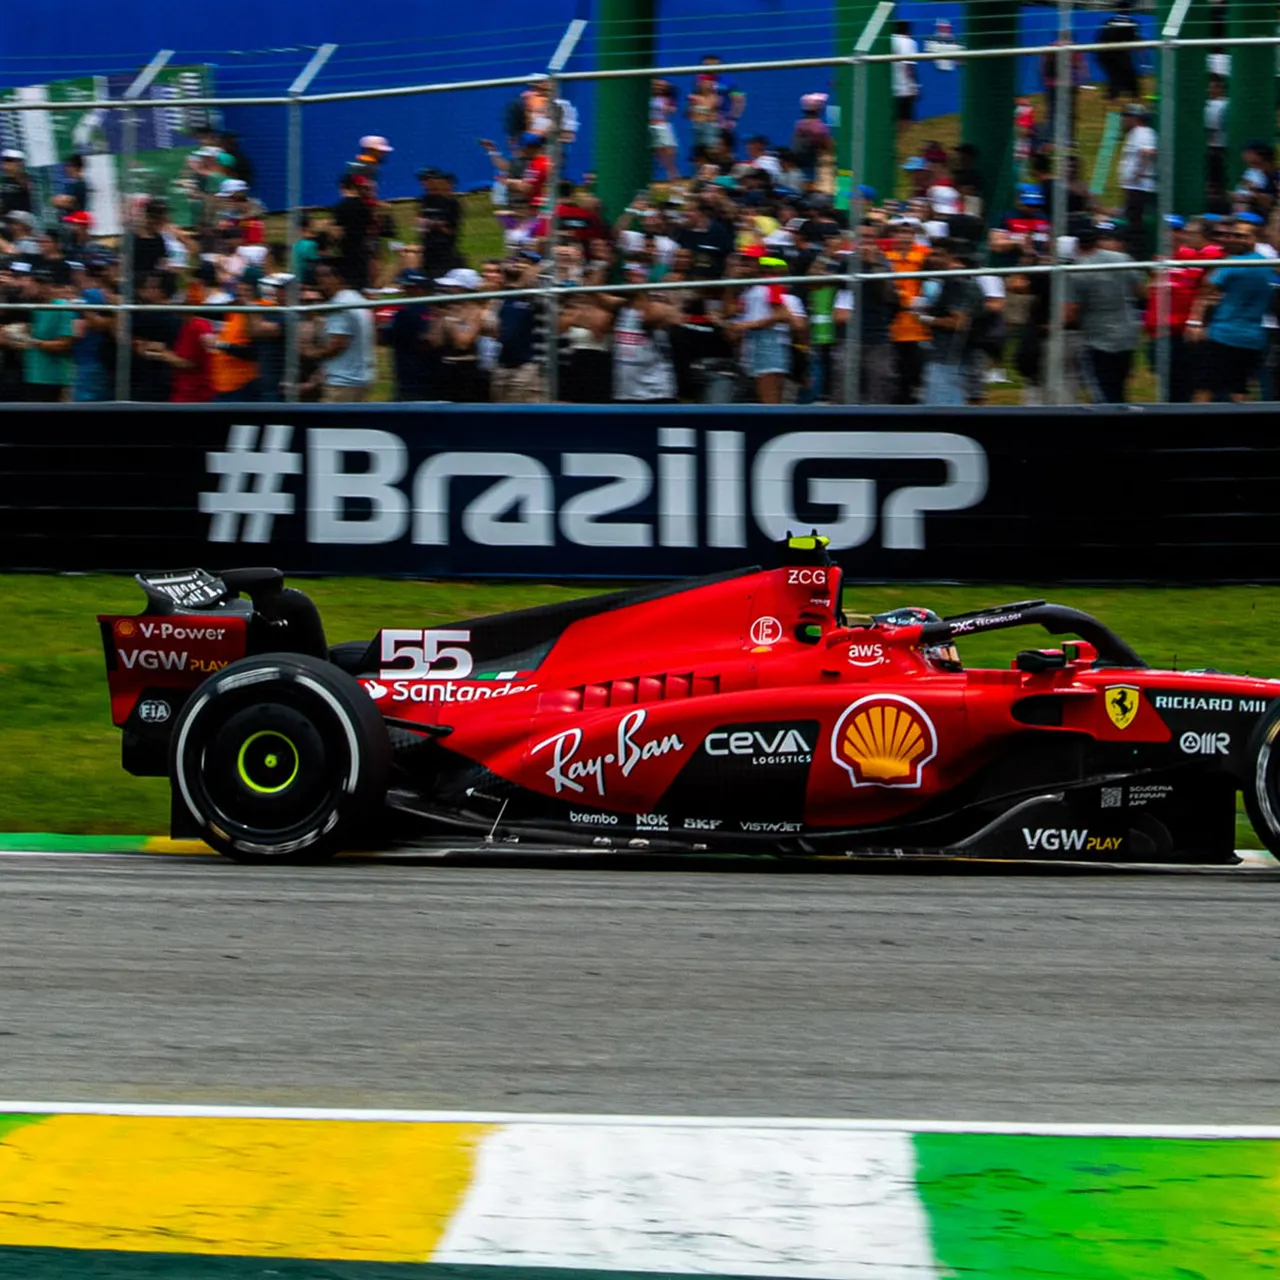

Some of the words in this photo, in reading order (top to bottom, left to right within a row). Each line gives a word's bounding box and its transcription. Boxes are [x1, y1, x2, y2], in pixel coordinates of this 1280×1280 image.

[198, 424, 989, 550] #BrazilGP
[788, 570, 826, 584] ZCG
[139, 623, 225, 640] V-Power
[118, 649, 188, 670] VGW
[379, 628, 473, 680] 55
[392, 681, 538, 702] Santander
[1155, 696, 1233, 711] RICHARD
[752, 754, 812, 764] LOGISTICS
[570, 811, 618, 825] brembo
[636, 814, 669, 825] NGK
[1022, 828, 1088, 850] VGW
[1086, 837, 1123, 850] PLAY
